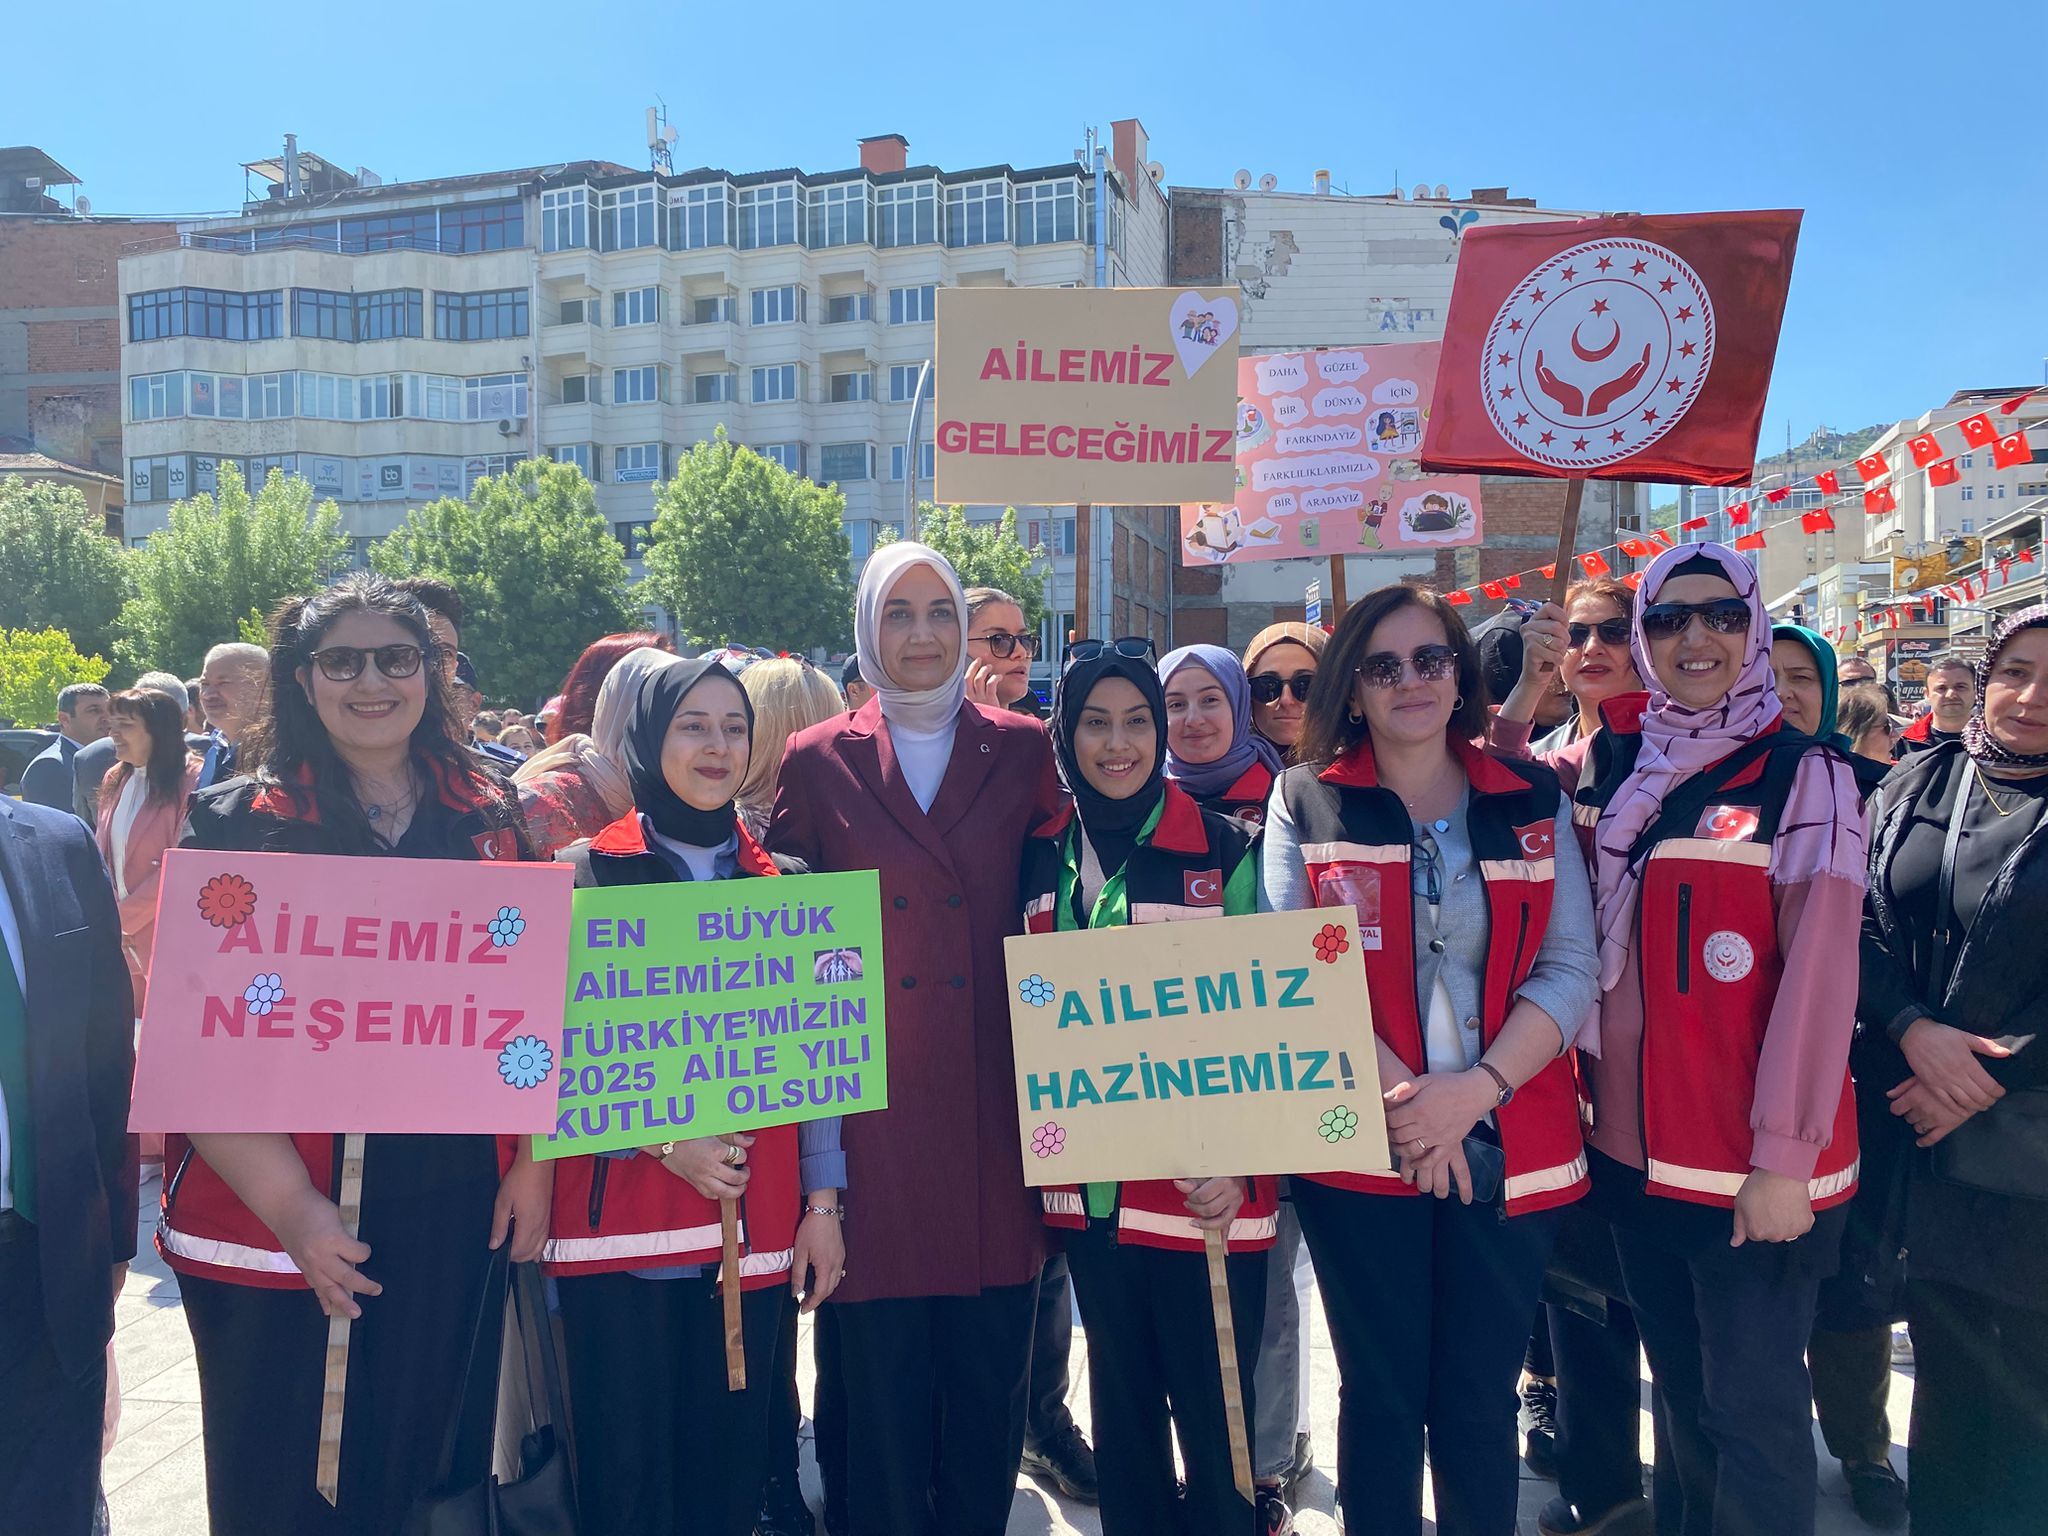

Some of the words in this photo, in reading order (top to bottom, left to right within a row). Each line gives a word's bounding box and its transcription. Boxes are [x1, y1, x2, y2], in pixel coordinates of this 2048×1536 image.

[980, 341, 1174, 387] AİLEMİZ
[1268, 367, 1299, 378] DAHA
[1323, 361, 1359, 373] GÜZEL
[1279, 405, 1297, 416] BİR
[1323, 396, 1362, 409] DÜNYA
[1389, 387, 1412, 399] İÇİN
[937, 421, 1232, 464] GELECEĞİMİZ
[1285, 430, 1357, 446] FARKINDAYIZ
[1274, 496, 1292, 509] BİR
[1305, 493, 1360, 508] ARADAYIZ
[217, 902, 508, 964] AİLEMİZ
[587, 918, 646, 948] EN
[698, 906, 835, 942] BÜYÜK
[574, 954, 795, 1002] AİLEMİZİN
[1057, 959, 1315, 1029] AİLEMİZ
[201, 993, 525, 1052] NEŞEMİZ
[562, 996, 868, 1058] TÜRKİYE'MİZİN
[558, 1061, 657, 1099] 2025
[683, 1044, 777, 1085] AİLE
[800, 1034, 871, 1070] YILI
[1026, 1042, 1356, 1111] HAZİNEMİZ!
[548, 1094, 695, 1142] KUTLU
[726, 1072, 862, 1114] OLSUN
